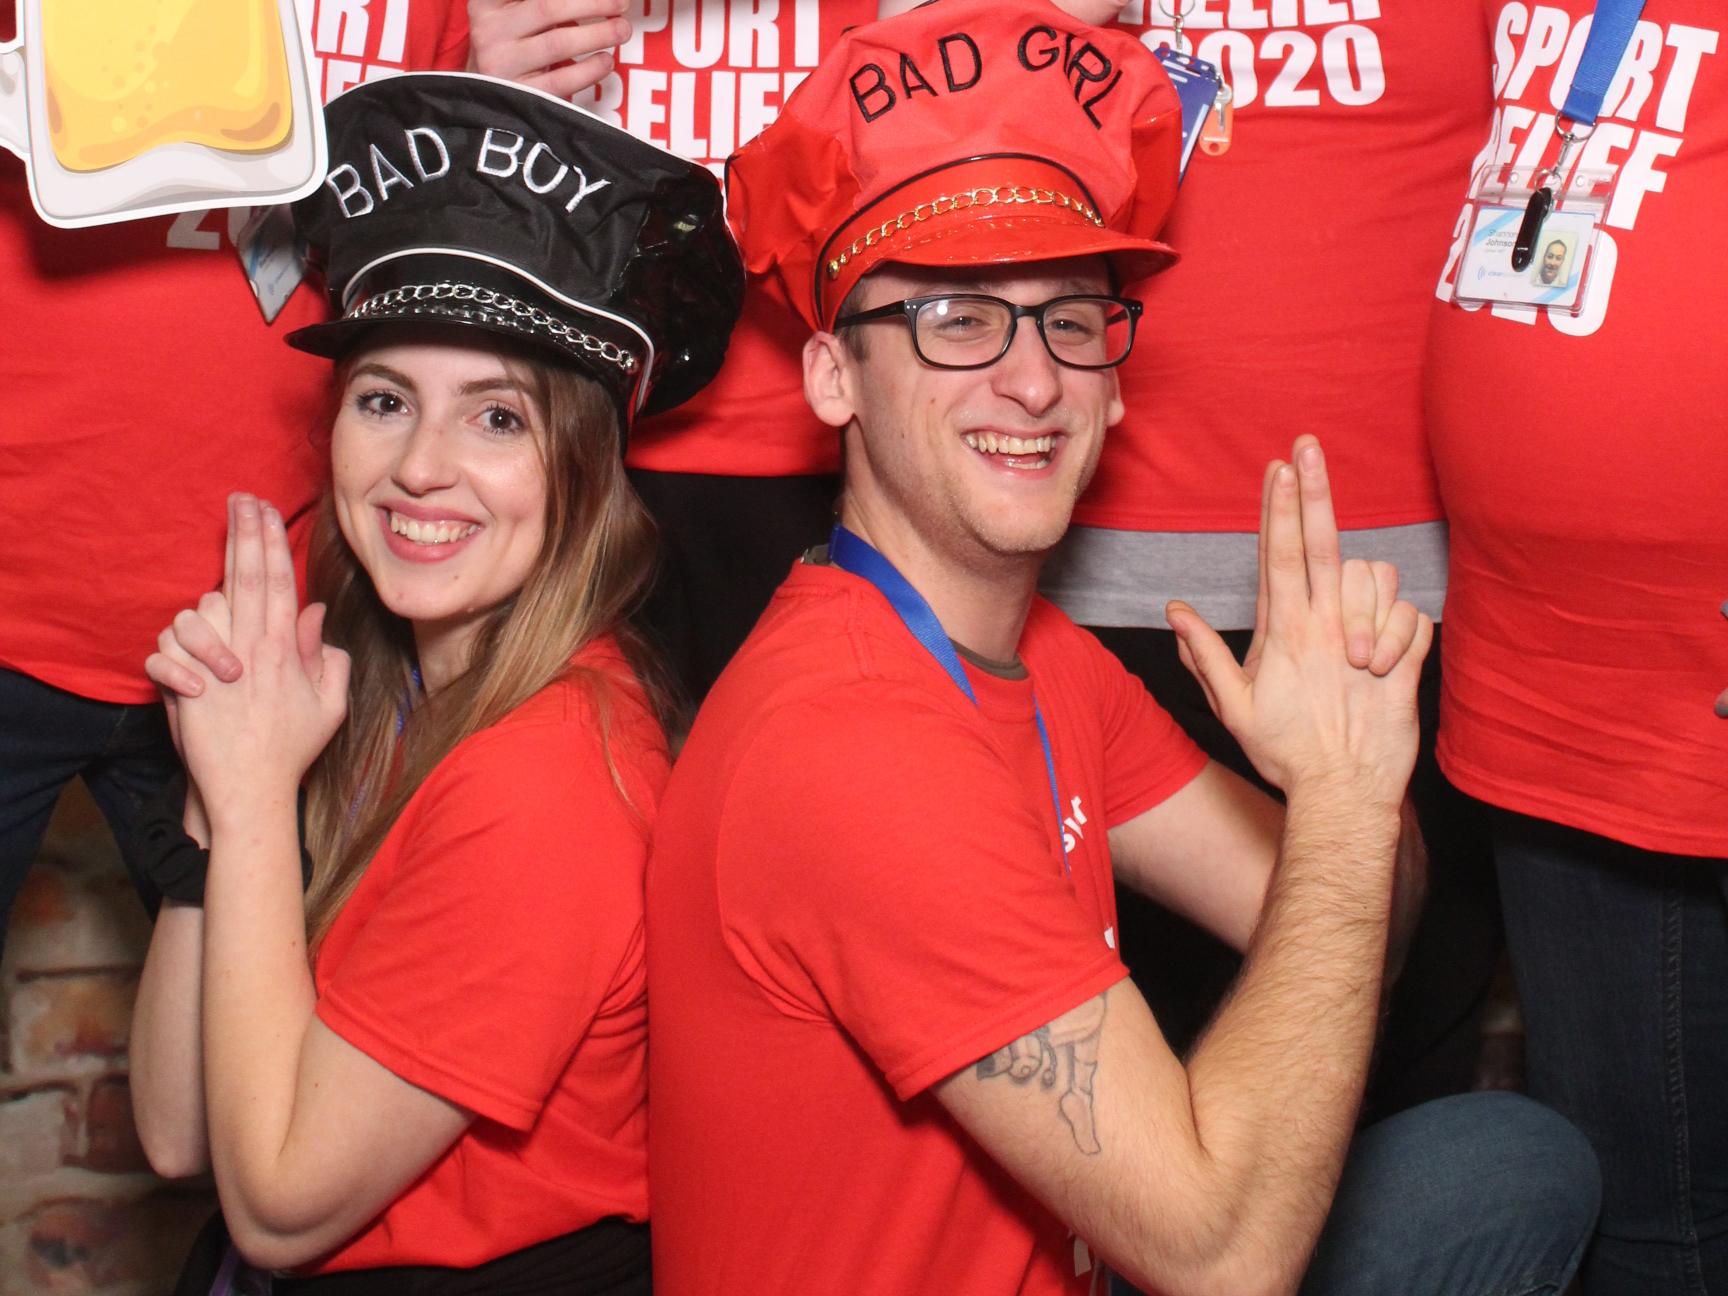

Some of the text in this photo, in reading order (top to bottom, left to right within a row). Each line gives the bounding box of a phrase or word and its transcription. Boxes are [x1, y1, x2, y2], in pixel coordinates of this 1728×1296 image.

[849, 25, 1123, 130] BAD GIRL
[325, 127, 450, 219] BAD
[476, 127, 612, 213] BOY
